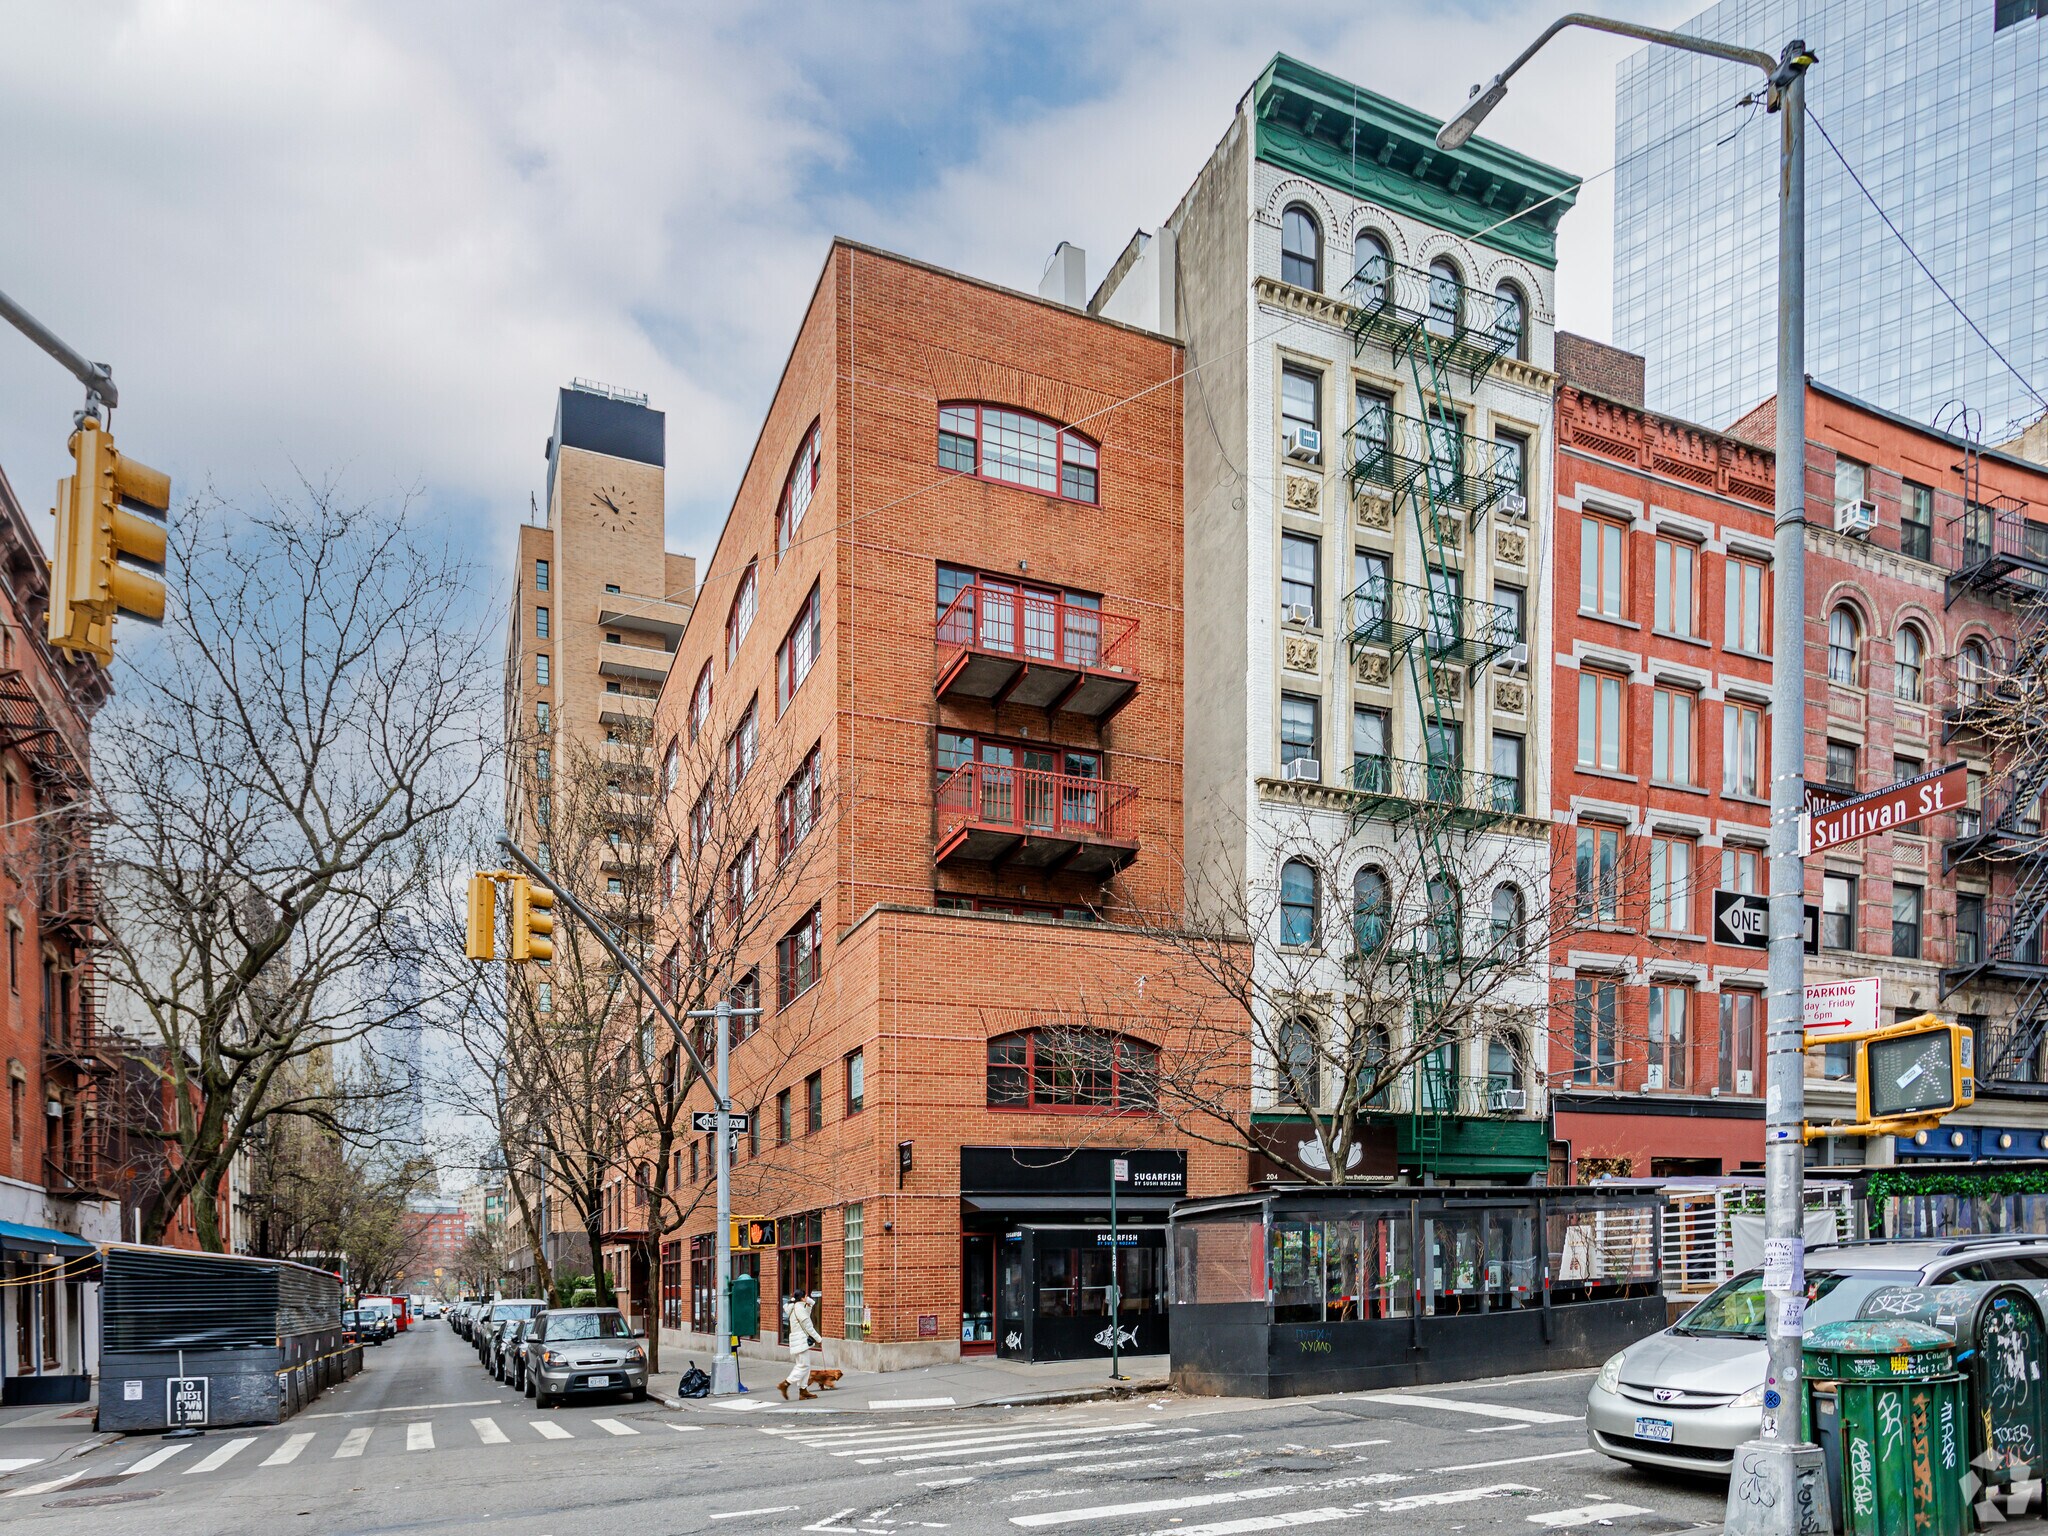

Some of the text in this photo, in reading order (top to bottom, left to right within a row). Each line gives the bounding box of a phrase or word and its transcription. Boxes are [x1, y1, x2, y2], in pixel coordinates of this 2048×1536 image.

[1814, 768, 1947, 818] SULLIVAN-THOMPSON HISTORIC DISTRICT
[1804, 788, 1838, 813] Spri
[1814, 781, 1944, 848] Sullivan St
[1731, 909, 1761, 932] ONE
[1806, 985, 1856, 998] PARKING
[1804, 999, 1855, 1011] day Friday
[1813, 1011, 1833, 1021] 6pm
[701, 1118, 742, 1127] ONE AY
[1134, 1173, 1182, 1181] SUGARFISH
[1266, 1173, 1278, 1181] 204
[964, 1328, 972, 1338] A
[1930, 1363, 1936, 1373] 2
